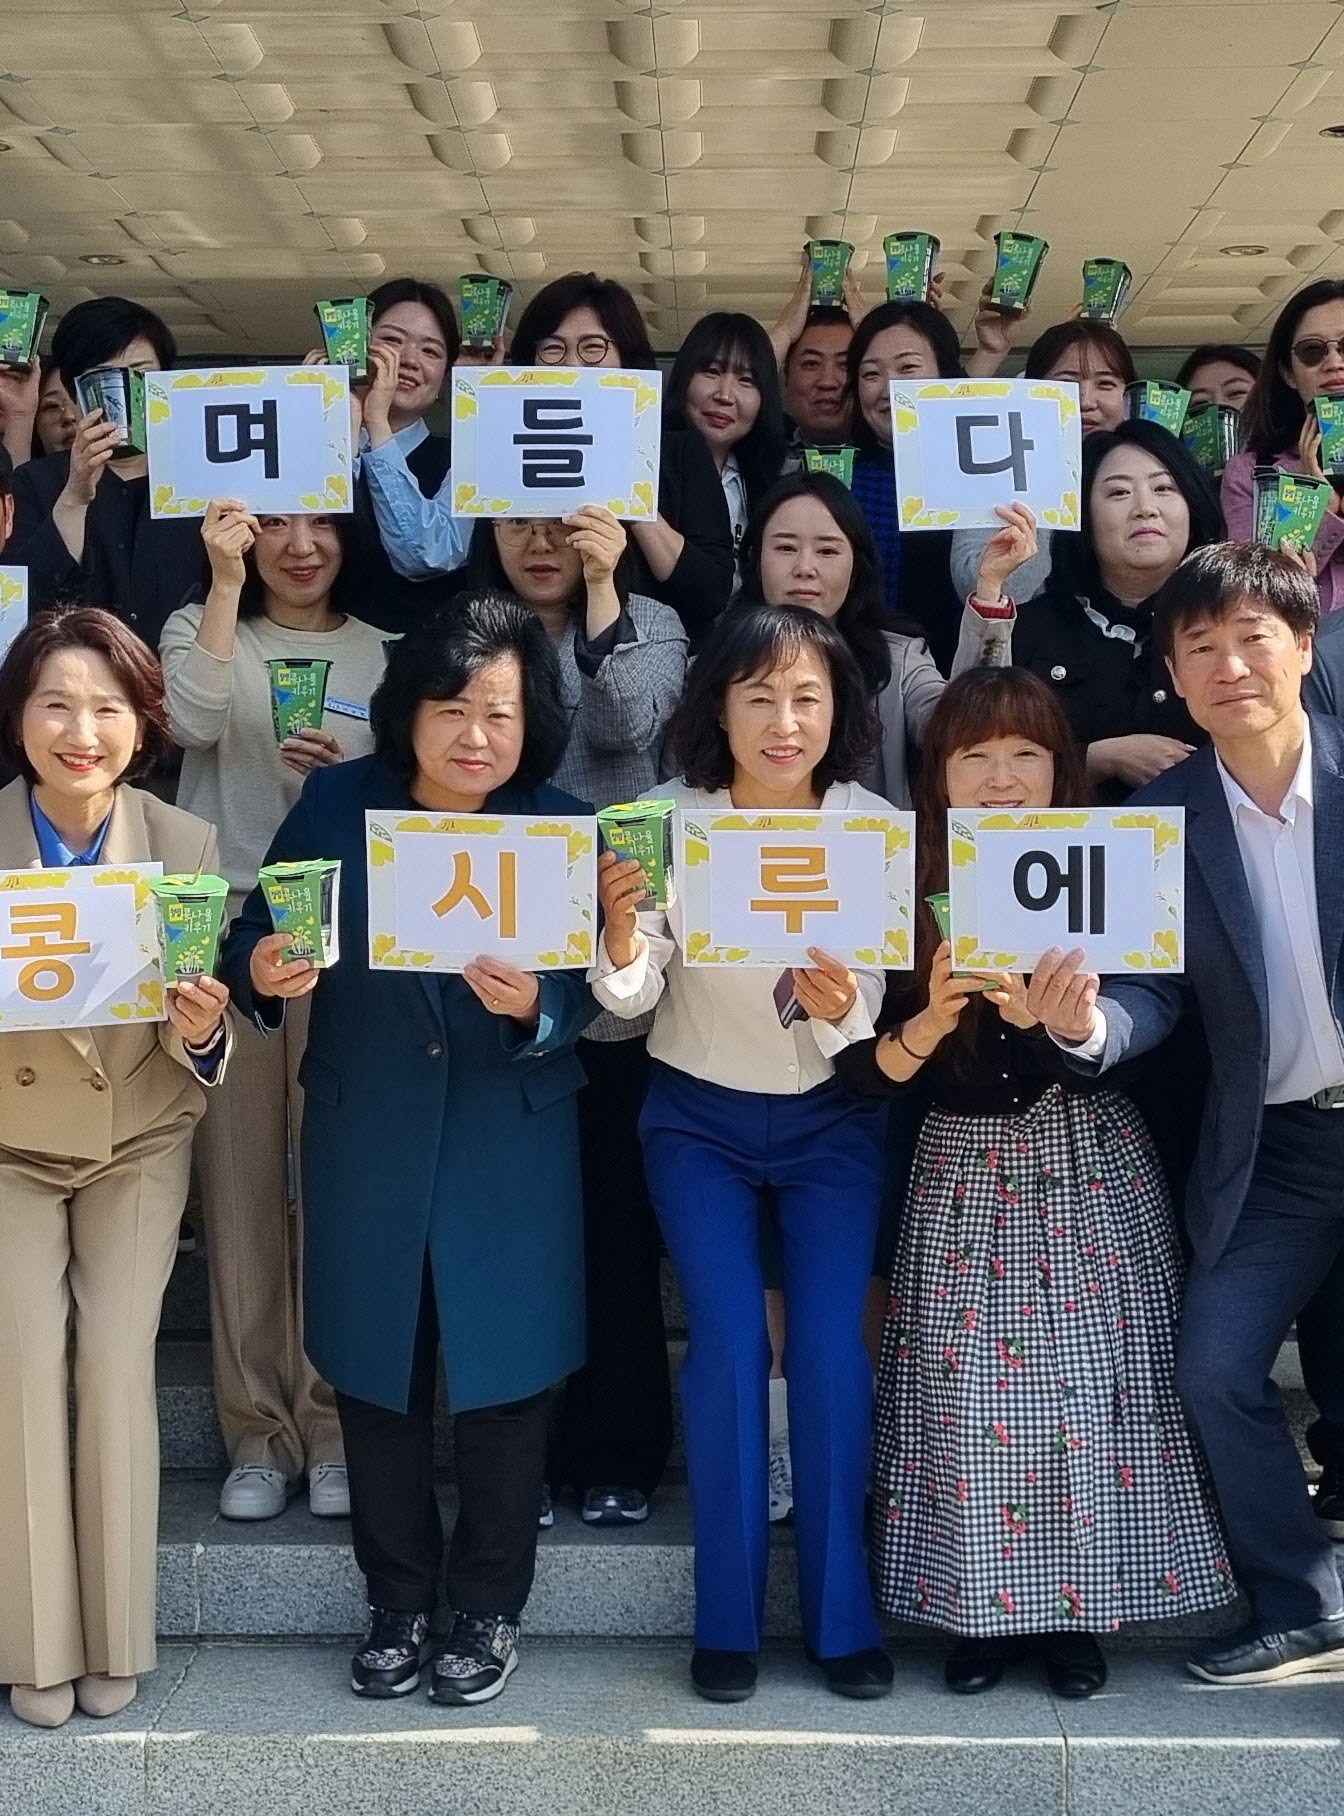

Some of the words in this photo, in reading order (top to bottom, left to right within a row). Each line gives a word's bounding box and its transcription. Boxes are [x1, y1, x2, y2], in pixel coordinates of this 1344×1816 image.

[205, 400, 279, 478] 며
[514, 400, 593, 487] 들
[956, 412, 1032, 491] 다
[432, 851, 517, 938] 시
[751, 846, 838, 933] 루
[1014, 846, 1104, 934] 에
[0, 903, 90, 999] 콩
